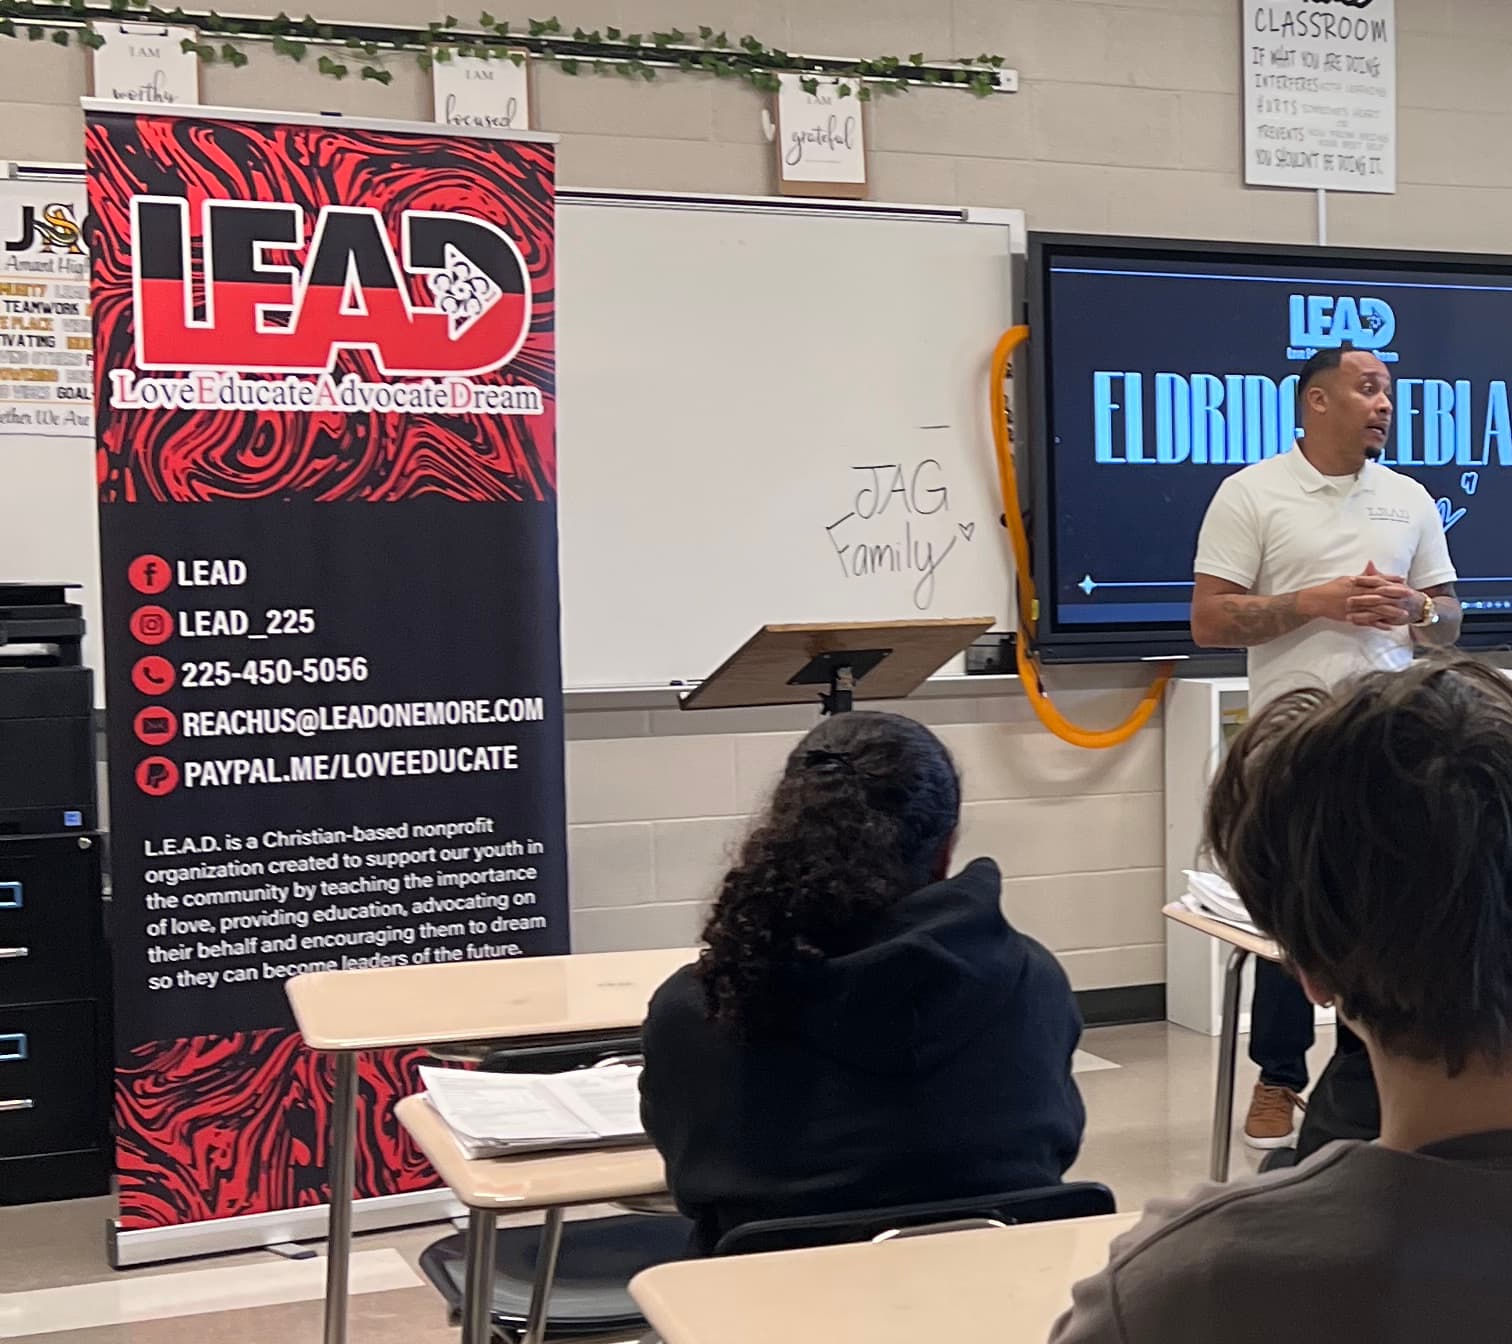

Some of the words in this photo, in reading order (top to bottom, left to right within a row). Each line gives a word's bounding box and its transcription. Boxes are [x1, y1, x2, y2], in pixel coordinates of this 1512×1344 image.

[1254, 7, 1388, 43] CLASSROOM
[140, 47, 161, 58] AM
[473, 70, 494, 80] AM
[785, 114, 855, 167] grateful
[4, 300, 80, 315] TEAMWORK
[130, 196, 532, 378] LEAD
[1288, 293, 1396, 350] LEAD
[850, 459, 949, 519] JAG
[177, 559, 247, 587] LEAD
[825, 512, 957, 610] Family
[178, 608, 316, 640] LEAD_225
[181, 656, 369, 688] 225-450-5056
[182, 697, 545, 737] REACHUS@LEADONEMORE.COM
[184, 745, 519, 788] PAYPAL.ME/LOVEEDUCATE
[145, 835, 222, 857] L.E.A.D.
[225, 834, 242, 851] is
[246, 836, 259, 850] a
[262, 823, 409, 848] Christian-based
[412, 816, 495, 839] nonprofit
[145, 859, 264, 886] organization
[267, 853, 340, 874] created
[343, 853, 363, 869] to
[365, 847, 437, 869] support
[439, 846, 471, 861] our
[473, 840, 524, 863] youth
[527, 838, 544, 855] in
[145, 892, 179, 910] the
[182, 883, 290, 908] community
[293, 881, 318, 901] by
[320, 875, 401, 896] teaching
[403, 872, 434, 890] the
[436, 866, 538, 889] importance
[146, 919, 168, 937] of
[219, 909, 309, 934] providing
[411, 892, 510, 915] advocating
[512, 891, 537, 907] on
[147, 944, 193, 964] their
[196, 937, 258, 959] behalf
[260, 934, 298, 954] and
[300, 925, 416, 949] encouraging
[419, 922, 466, 940] them
[468, 919, 488, 935] to
[490, 915, 547, 933] dream
[148, 974, 174, 991] so
[176, 969, 219, 989] they
[222, 967, 259, 984] can
[262, 961, 339, 981] become
[341, 952, 409, 972] leaders
[412, 946, 433, 965] of
[434, 945, 463, 964] the
[466, 942, 524, 960] future.
